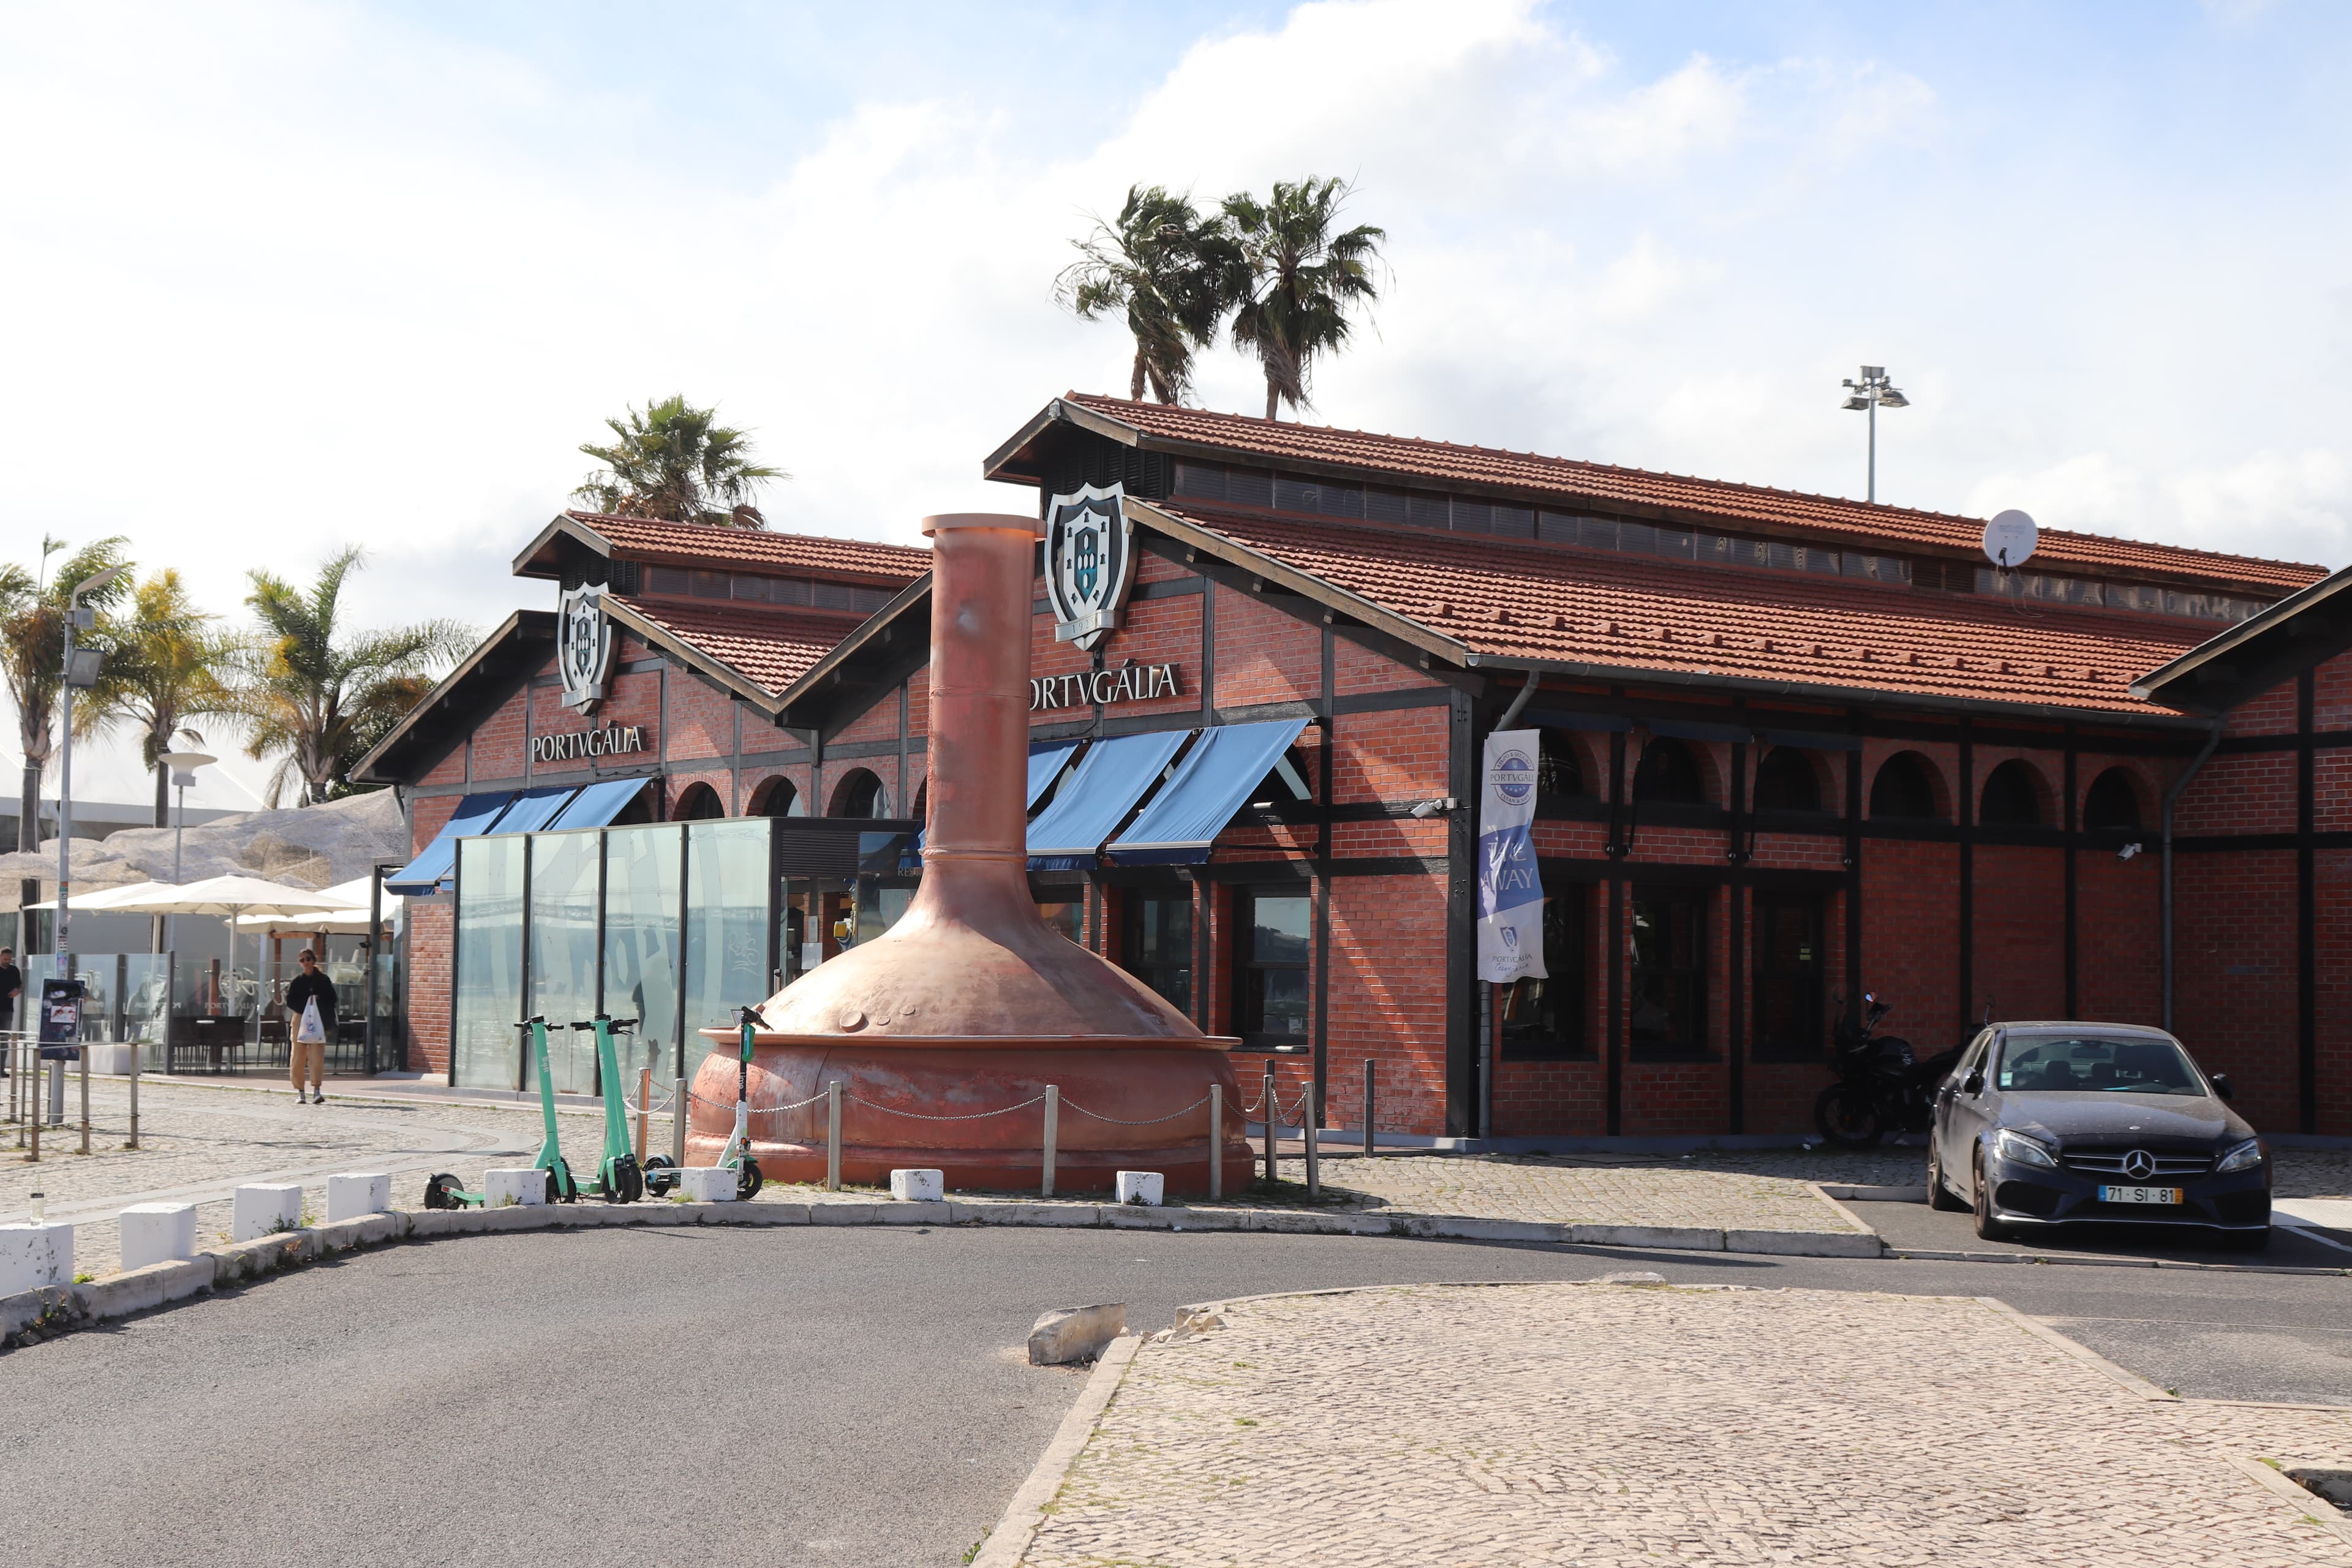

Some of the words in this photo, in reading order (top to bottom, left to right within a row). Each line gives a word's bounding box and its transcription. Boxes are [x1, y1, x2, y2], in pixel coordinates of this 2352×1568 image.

[1072, 616, 1094, 634] 1925
[532, 720, 642, 762] PORTVGÁLIA
[1500, 793, 1516, 804] CLEAN
[1487, 842, 1527, 862] TAKE
[1481, 867, 1534, 891] AWAY
